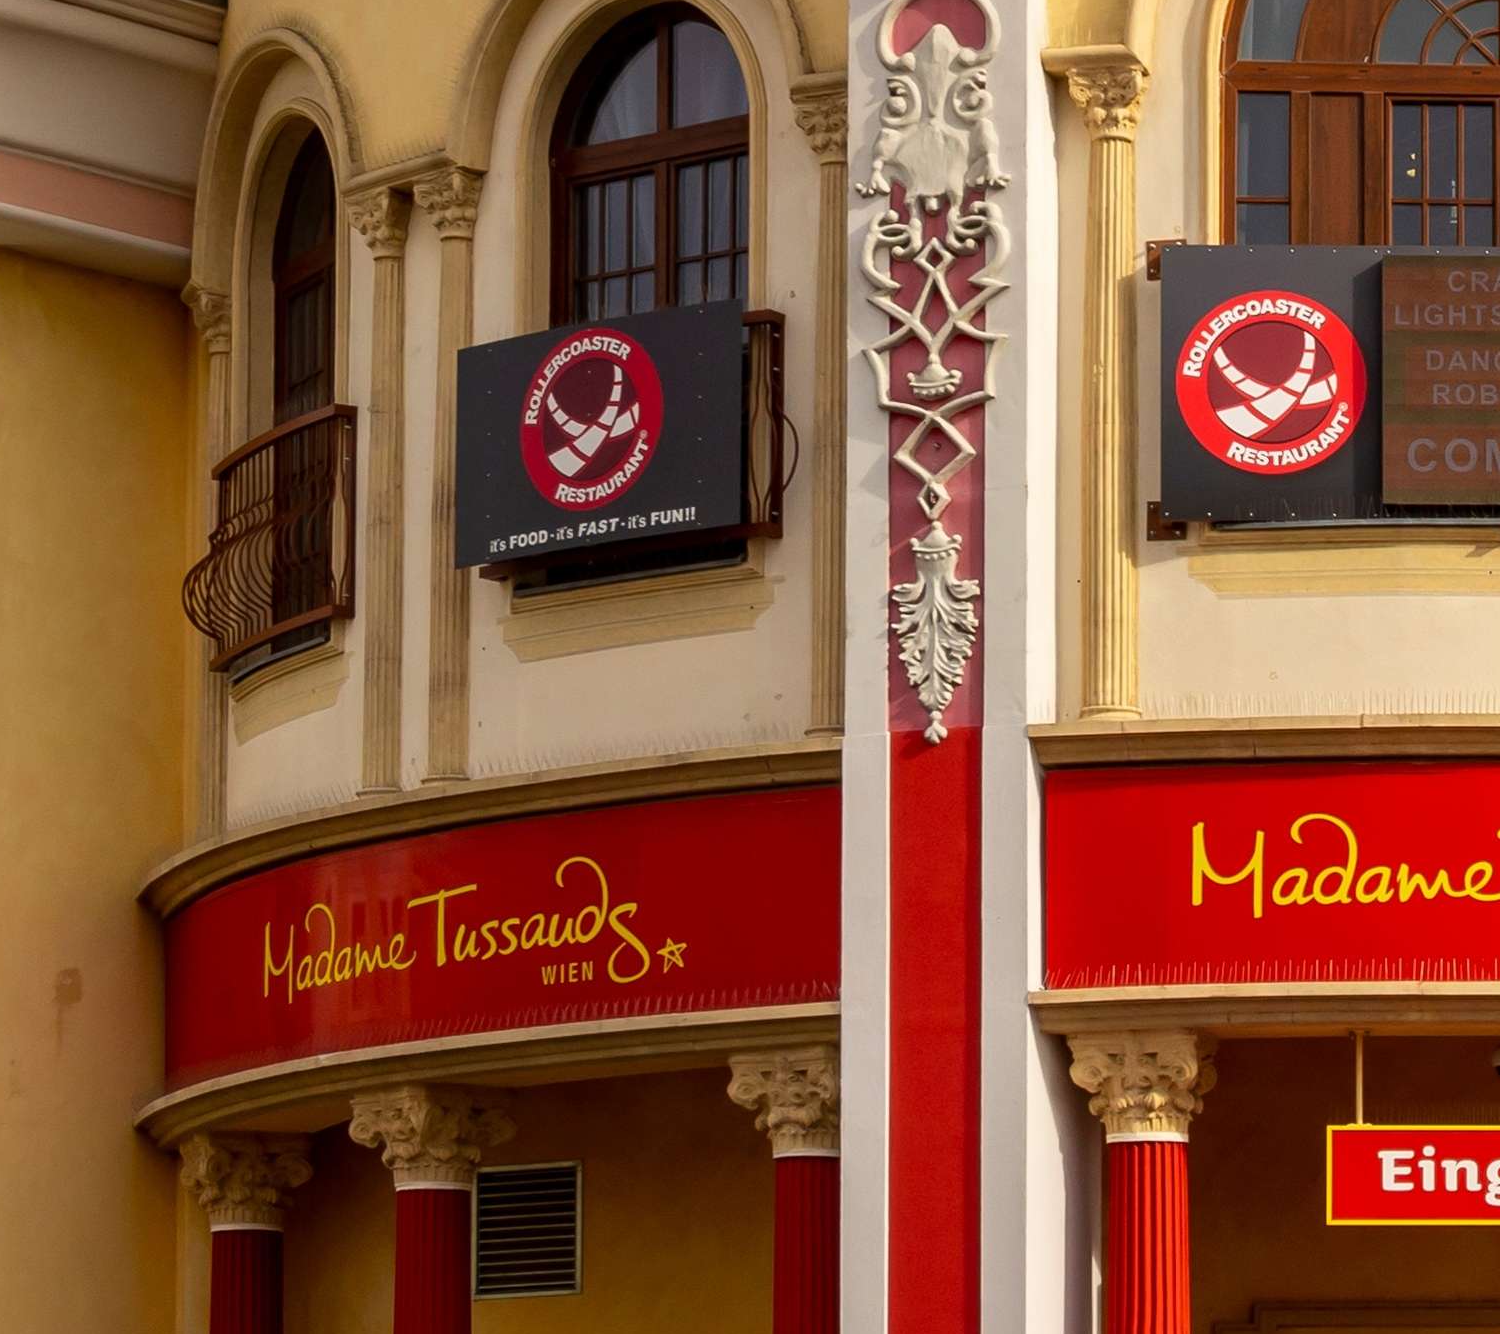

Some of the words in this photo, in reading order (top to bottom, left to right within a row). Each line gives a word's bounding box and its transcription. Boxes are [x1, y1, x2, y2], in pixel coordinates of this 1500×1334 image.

[1183, 298, 1327, 379] ROLLERCOASTER
[524, 336, 632, 425] ROLLERCOASTER
[1227, 410, 1350, 467] RESTAURANT
[555, 439, 649, 504] RESTAURANT
[509, 529, 548, 549] FOOD
[577, 517, 620, 538] FAST
[650, 507, 696, 526] FUN!!
[263, 903, 417, 1004] Madame
[406, 855, 651, 984] Tussauds
[541, 961, 594, 986] WIEN
